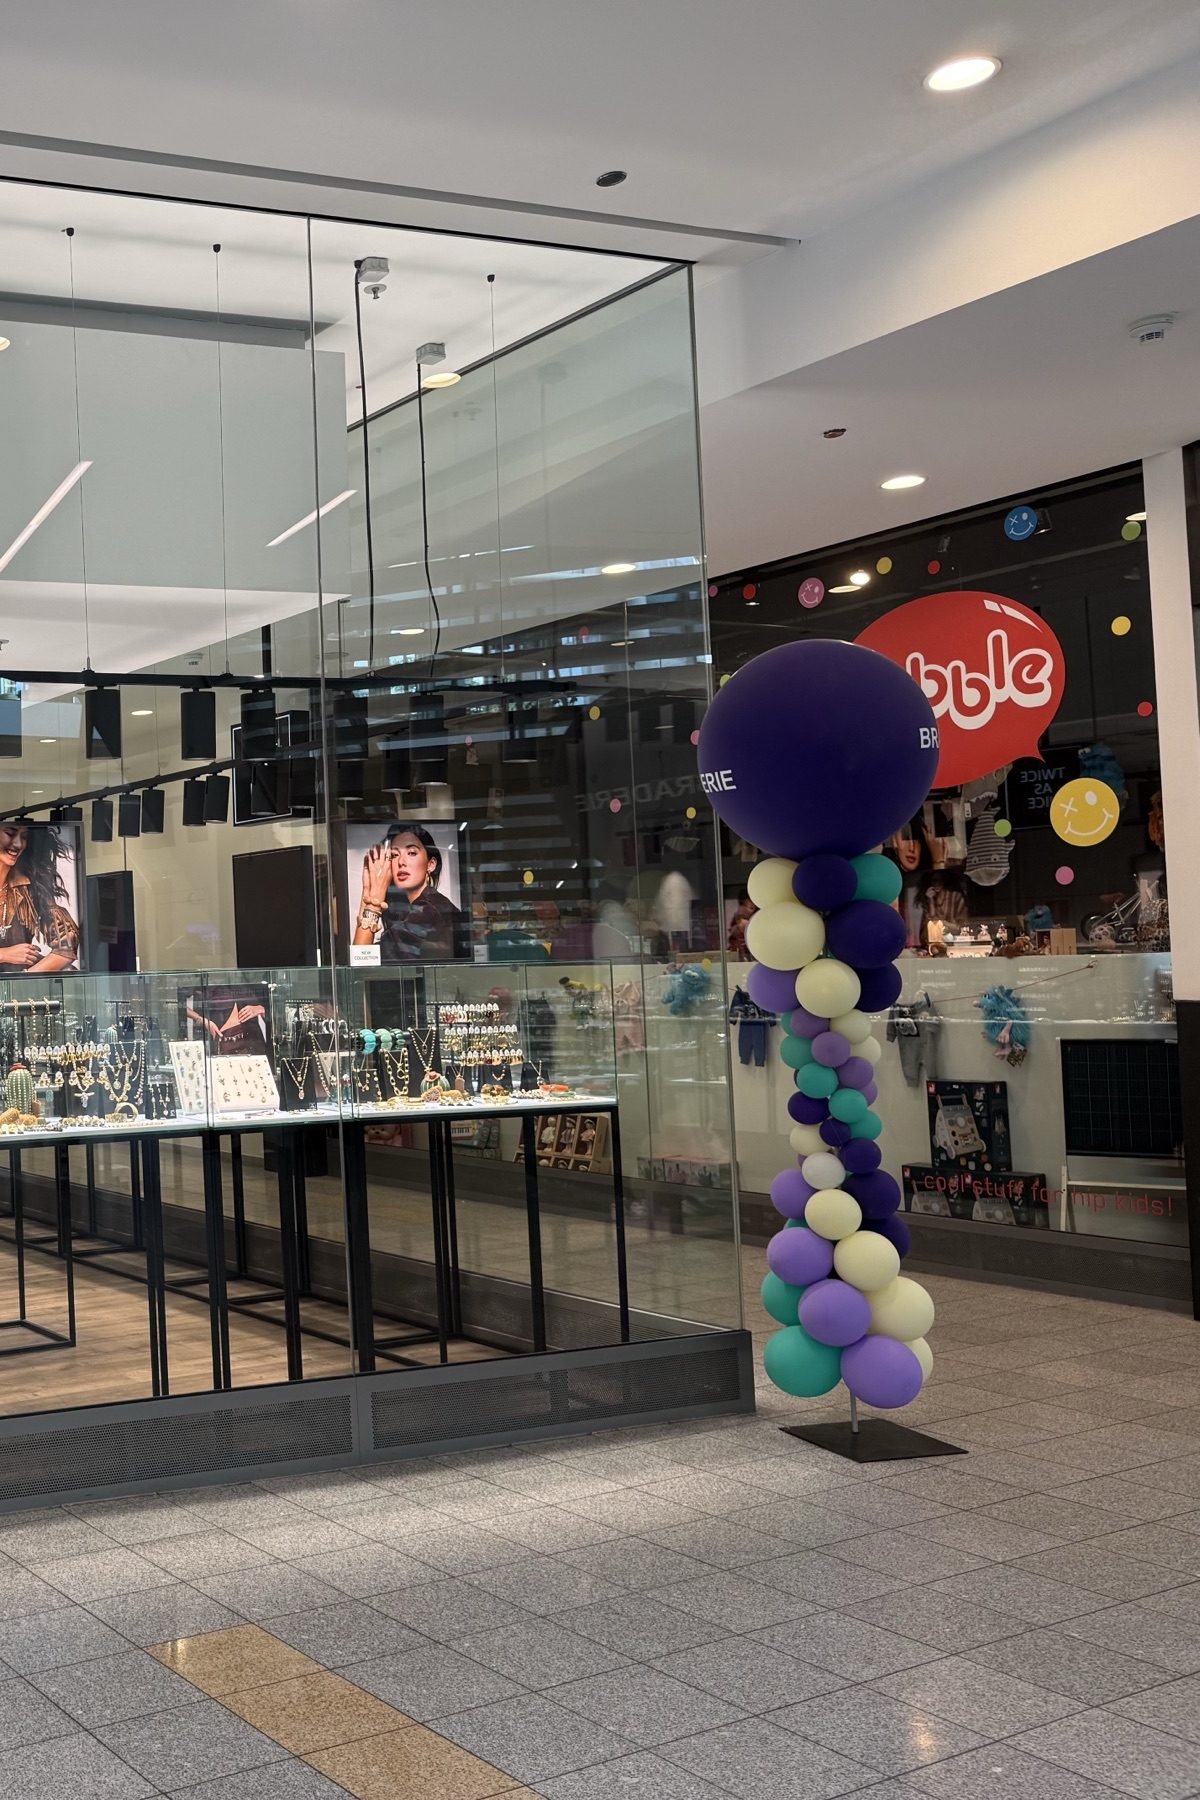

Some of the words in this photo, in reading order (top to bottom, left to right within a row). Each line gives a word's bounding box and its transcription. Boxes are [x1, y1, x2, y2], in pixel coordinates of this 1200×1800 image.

[919, 727, 940, 749] BR
[699, 769, 737, 793] ERIE
[924, 1174, 964, 1193] cool
[972, 1177, 1024, 1200] stuff
[1071, 1184, 1106, 1216] hip
[1114, 1190, 1173, 1217] kids!
